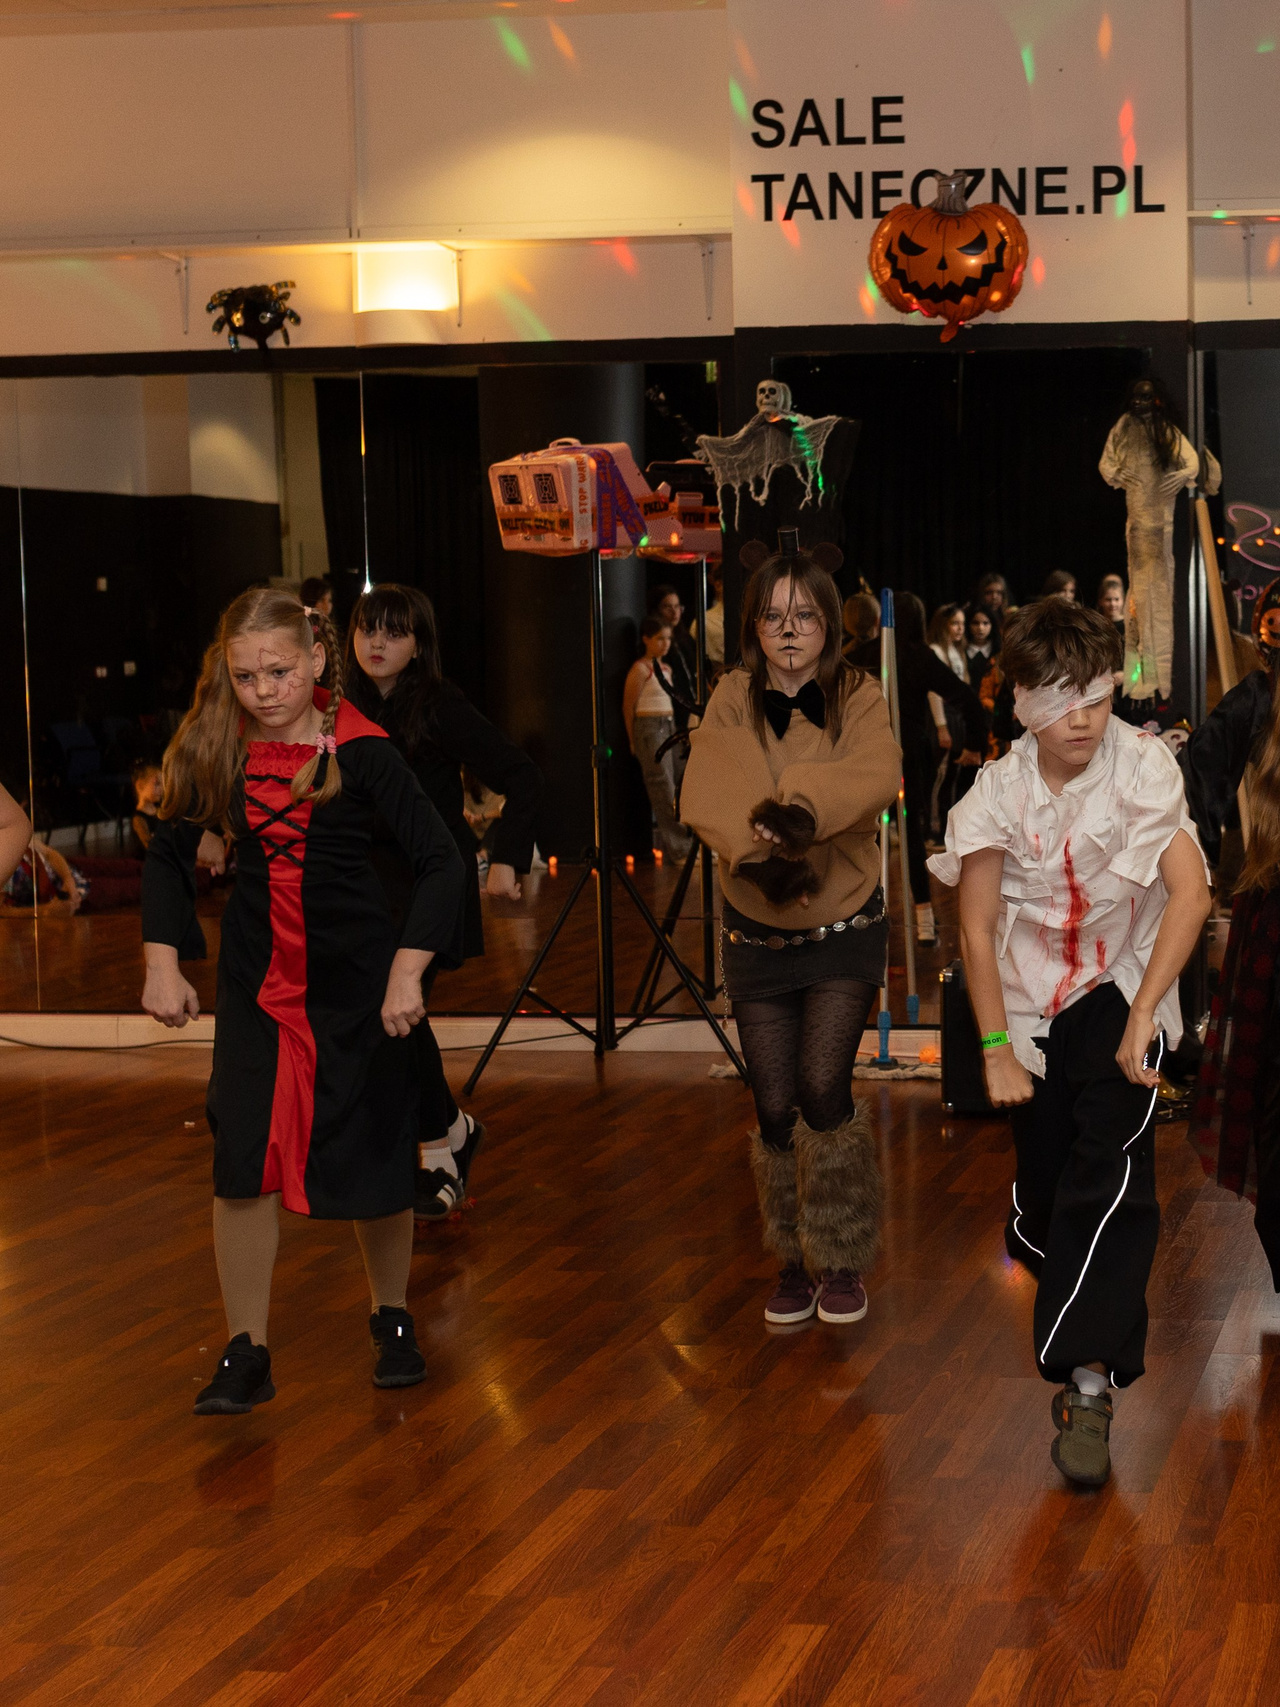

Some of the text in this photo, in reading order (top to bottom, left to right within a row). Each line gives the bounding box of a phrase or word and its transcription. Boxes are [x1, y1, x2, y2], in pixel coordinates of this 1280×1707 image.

[751, 96, 905, 149] SALE
[578, 487, 588, 515] STOP
[992, 1036, 1002, 1044] LEO
